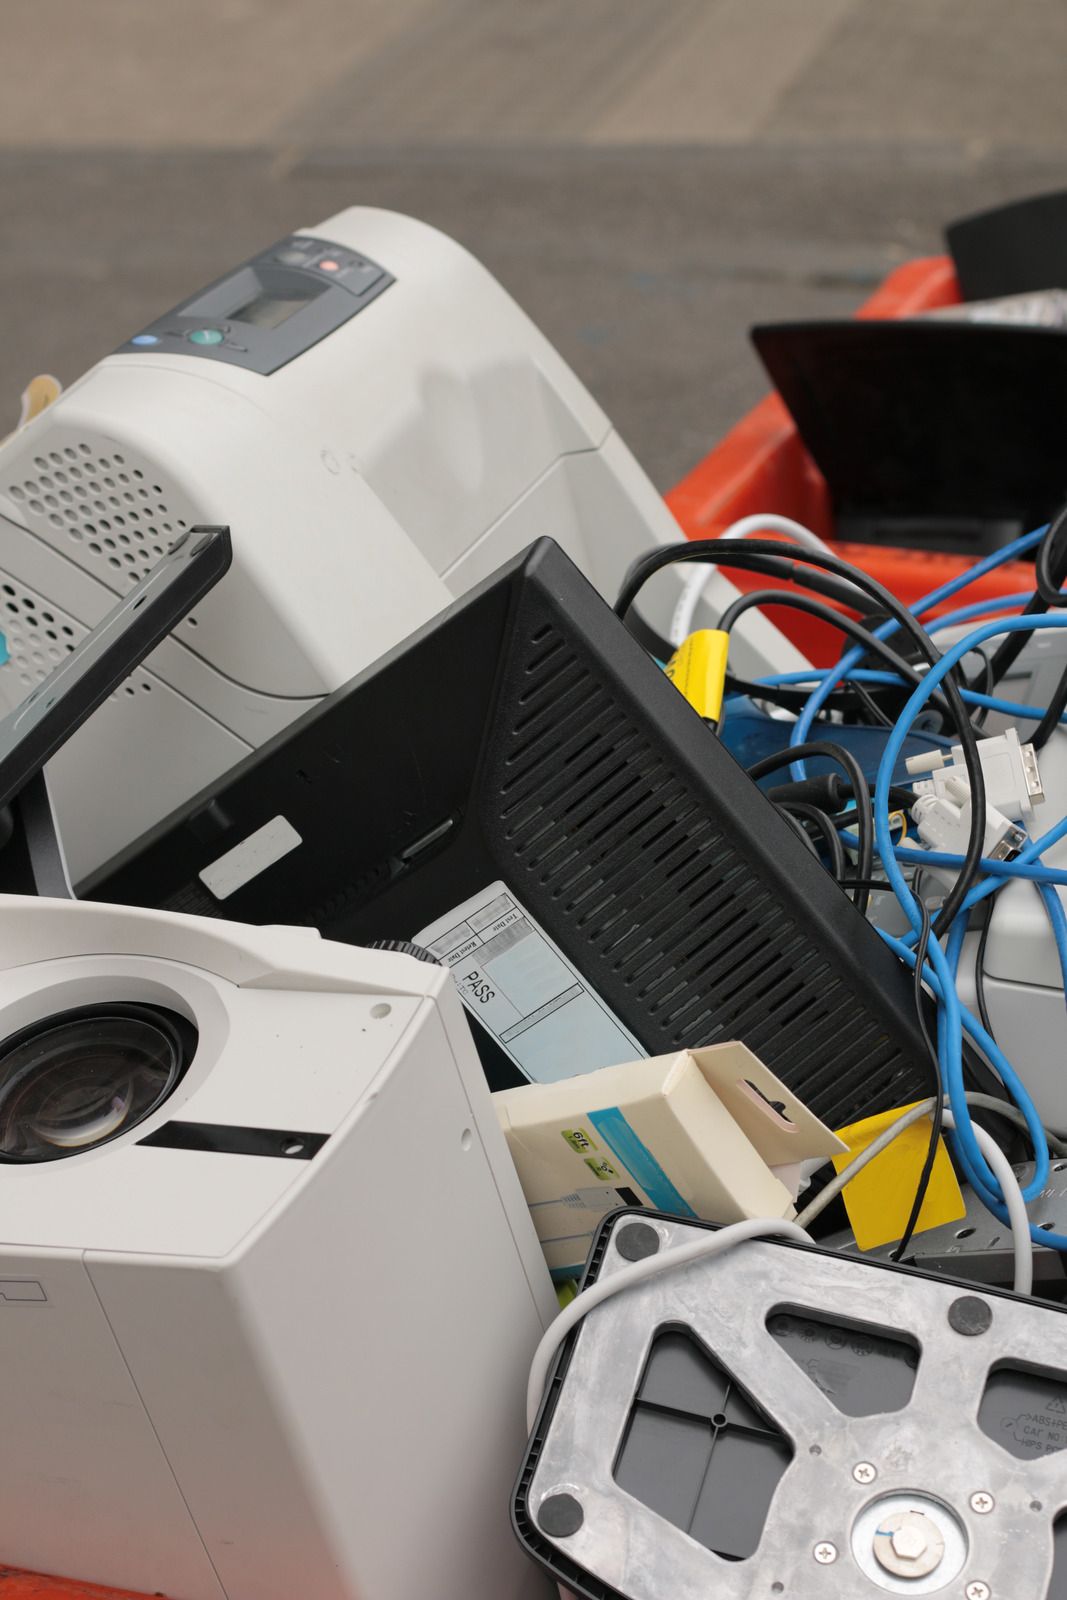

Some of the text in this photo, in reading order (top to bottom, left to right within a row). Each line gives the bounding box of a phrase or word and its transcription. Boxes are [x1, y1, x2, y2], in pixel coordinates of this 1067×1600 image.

[493, 913, 518, 931] Test Date
[462, 971, 495, 1004] PASS
[573, 1132, 589, 1147] 6ft
